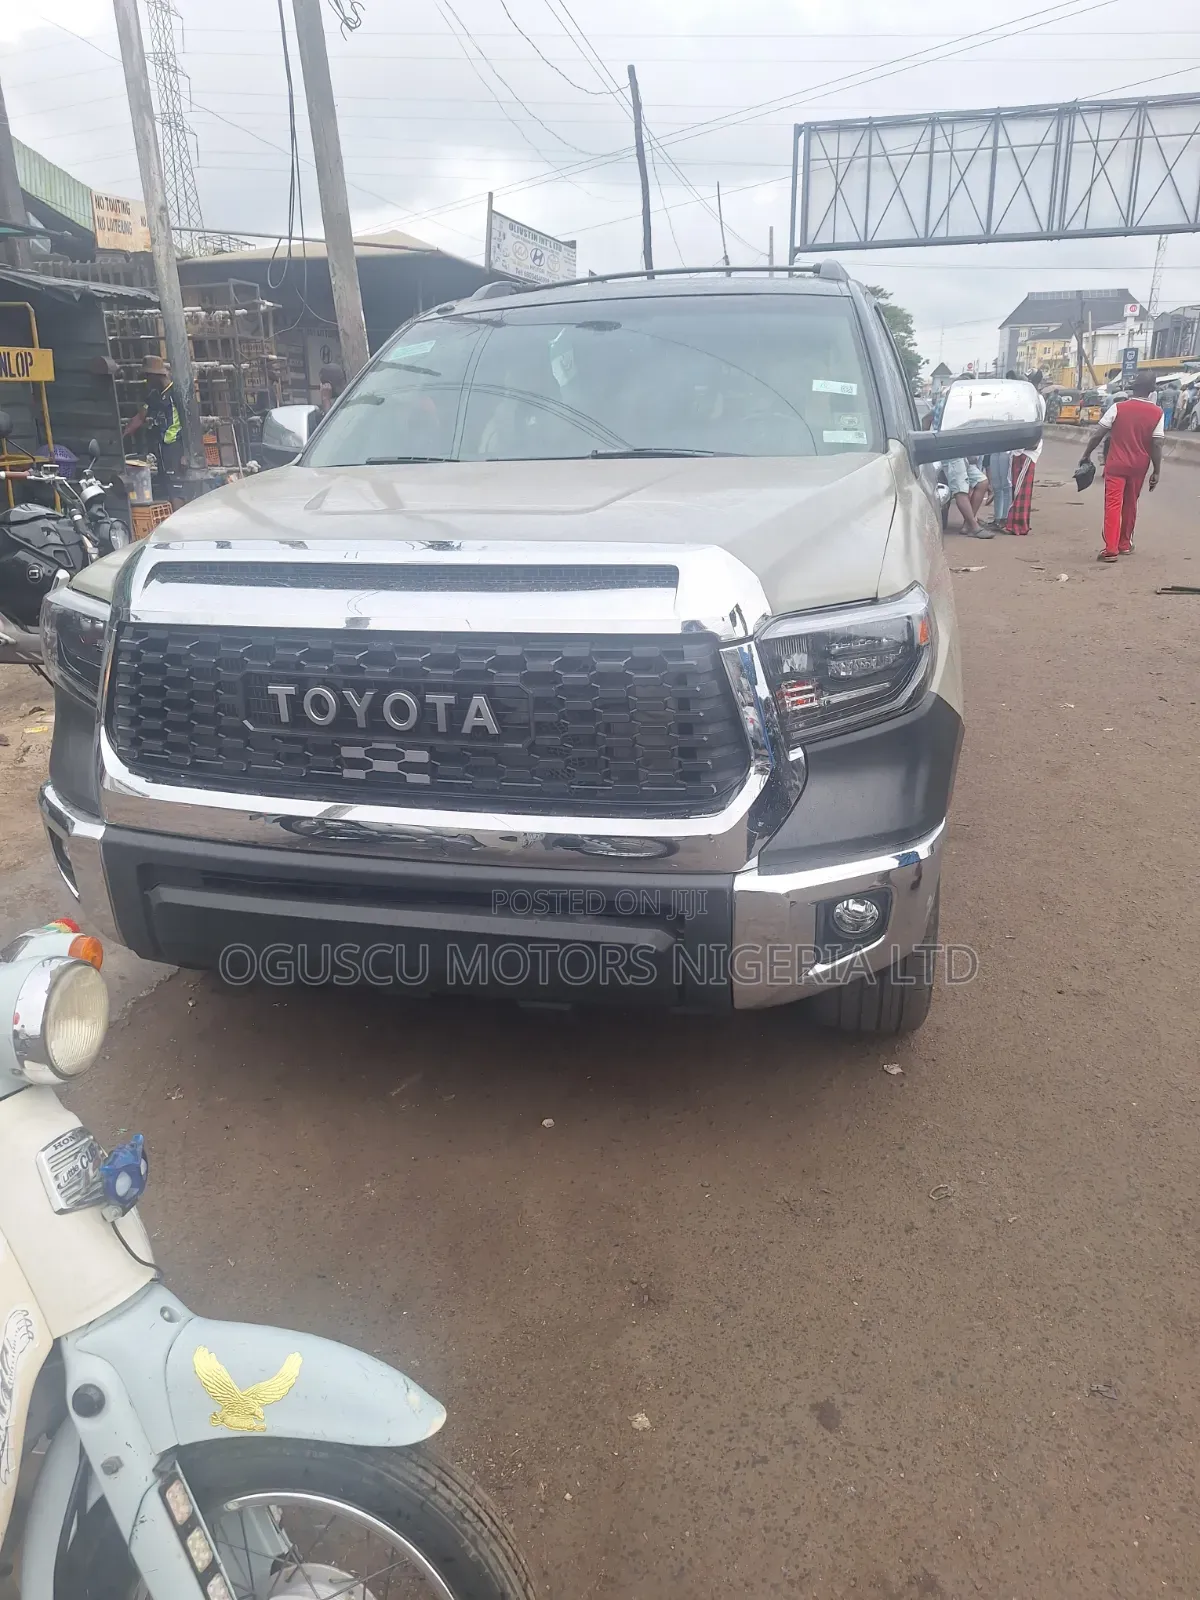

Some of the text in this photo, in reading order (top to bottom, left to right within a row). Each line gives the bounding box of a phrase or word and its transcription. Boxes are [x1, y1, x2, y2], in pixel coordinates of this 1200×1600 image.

[94, 194, 130, 216] NO TOUTING
[96, 215, 106, 231] NO
[267, 685, 500, 734] TOYOTA
